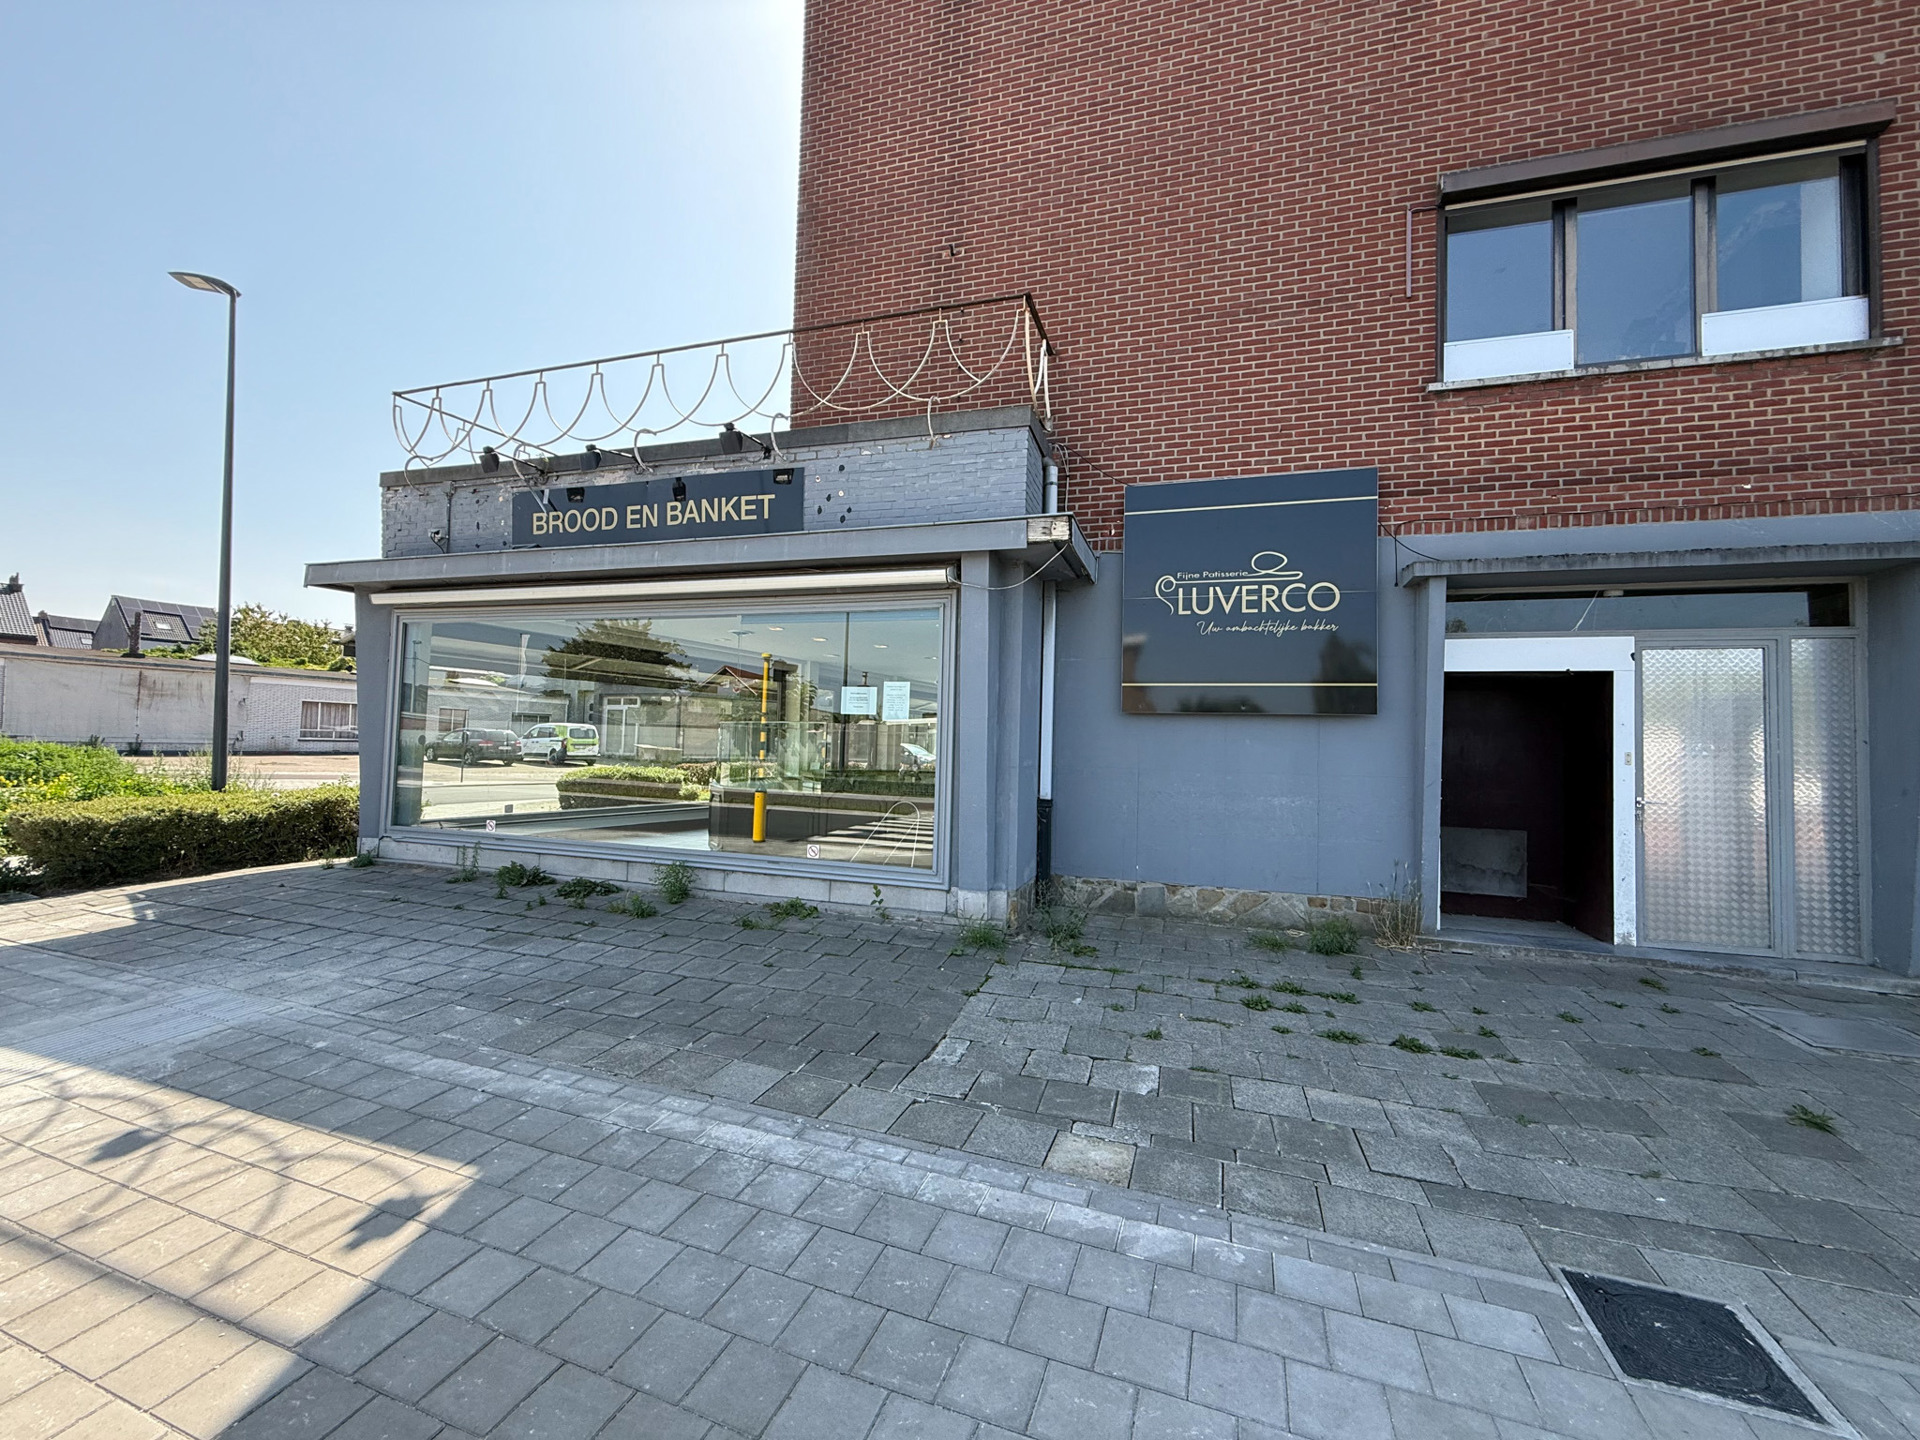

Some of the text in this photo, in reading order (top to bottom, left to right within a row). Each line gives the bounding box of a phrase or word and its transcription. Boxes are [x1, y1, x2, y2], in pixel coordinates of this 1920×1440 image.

[532, 494, 776, 535] BROOD EN BANKET
[1177, 569, 1249, 580] Fijne Patisserie
[1177, 581, 1341, 615] LUVERCO
[1196, 618, 1339, 638] Uw ambachtelijke bakker
